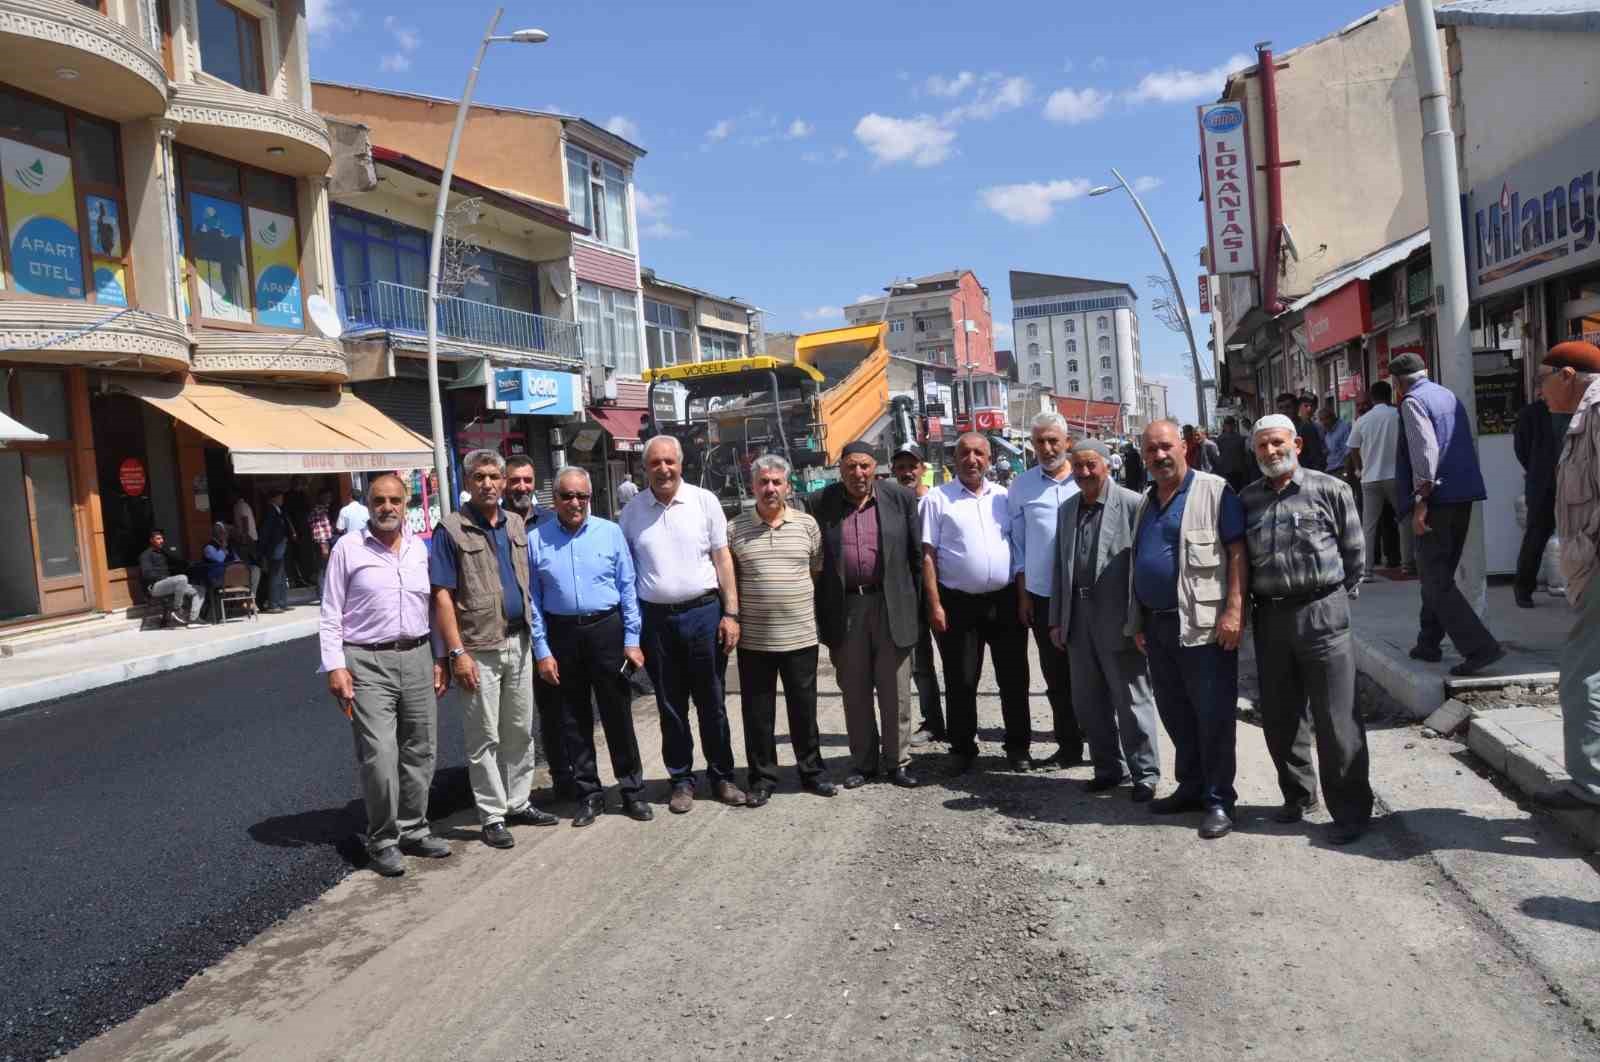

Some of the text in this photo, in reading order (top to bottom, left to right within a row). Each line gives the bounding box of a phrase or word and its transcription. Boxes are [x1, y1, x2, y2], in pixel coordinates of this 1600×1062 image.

[1215, 141, 1244, 263] LOKANTASI
[1475, 170, 1600, 270] Milang
[22, 236, 76, 258] APART
[29, 261, 74, 282] OTEL
[262, 281, 298, 297] APART
[268, 300, 298, 314] OTEL
